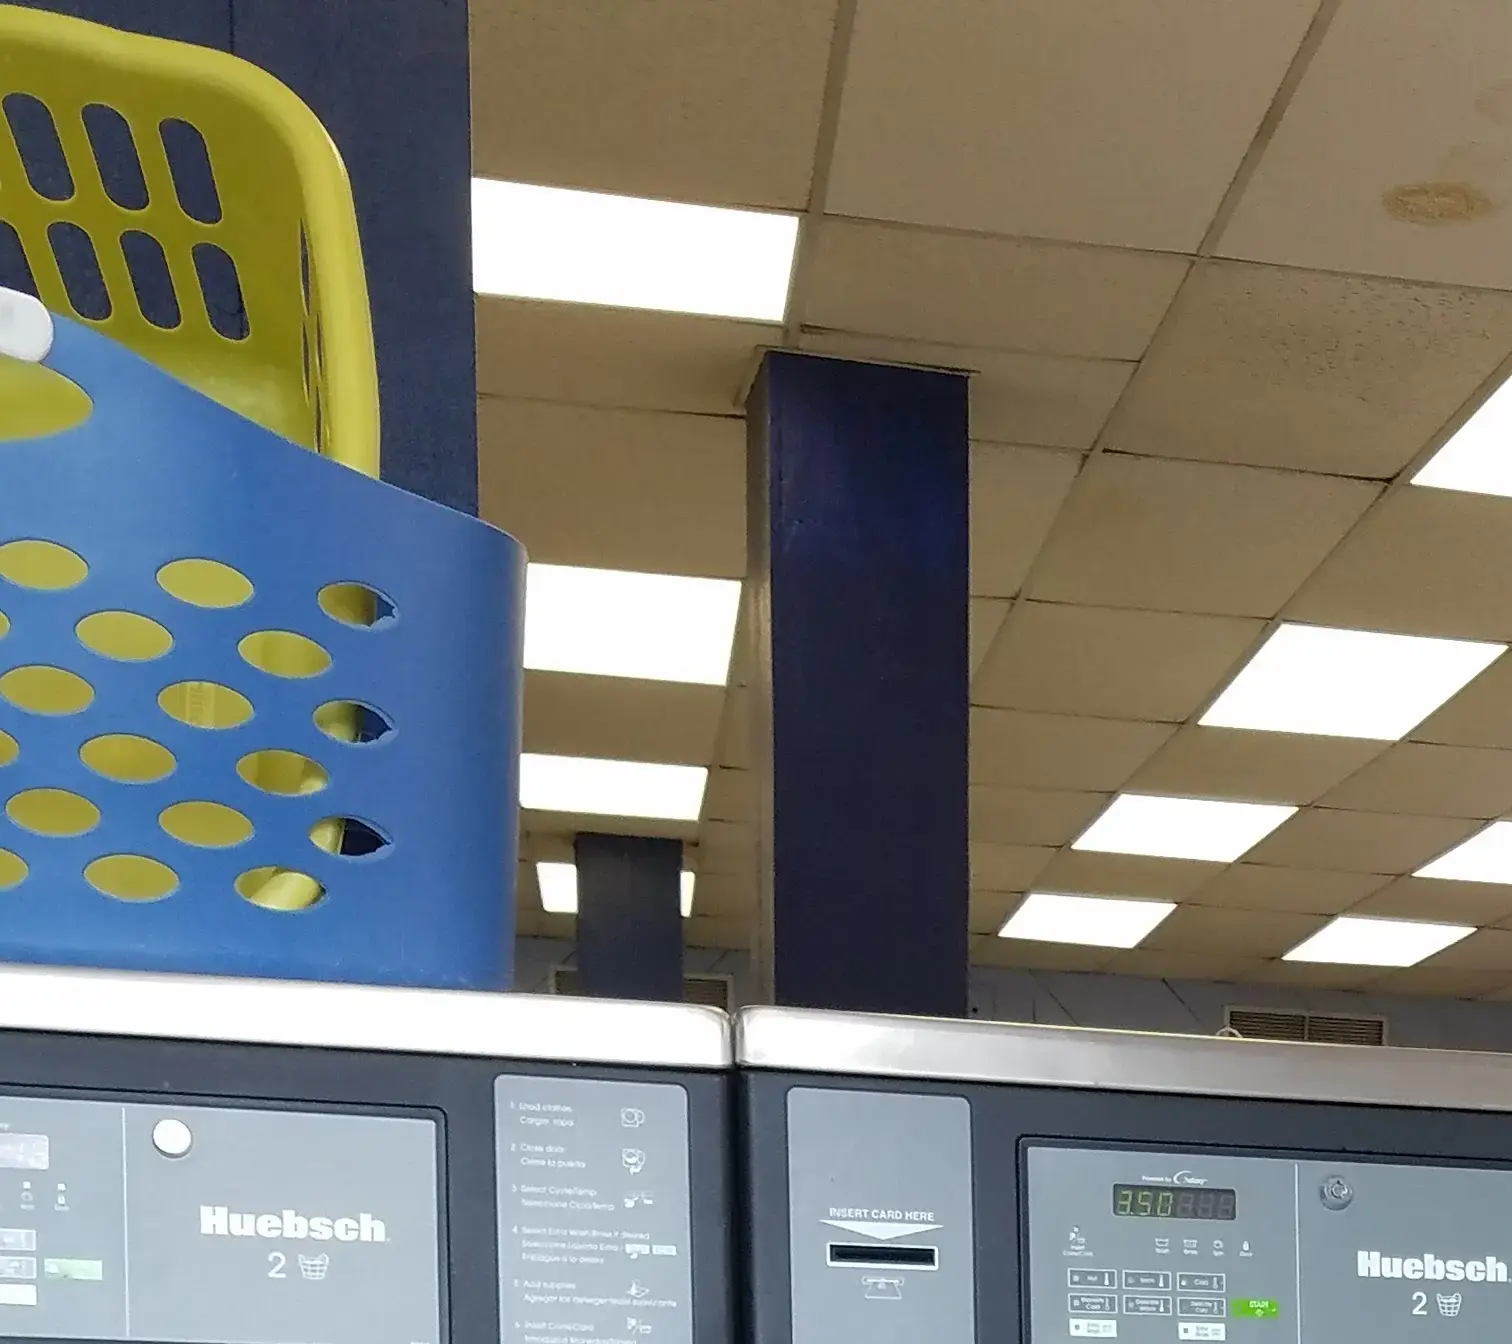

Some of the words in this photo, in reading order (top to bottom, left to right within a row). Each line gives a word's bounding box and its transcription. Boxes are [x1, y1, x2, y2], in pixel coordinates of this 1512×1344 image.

[200, 1205, 390, 1243] Huebsch
[829, 1207, 869, 1218] INSERT
[871, 1209, 902, 1220] CARD
[905, 1211, 935, 1221] HERE
[267, 1251, 288, 1279] 2
[1357, 1250, 1511, 1283] Huebsch
[1411, 1291, 1428, 1316] 2
